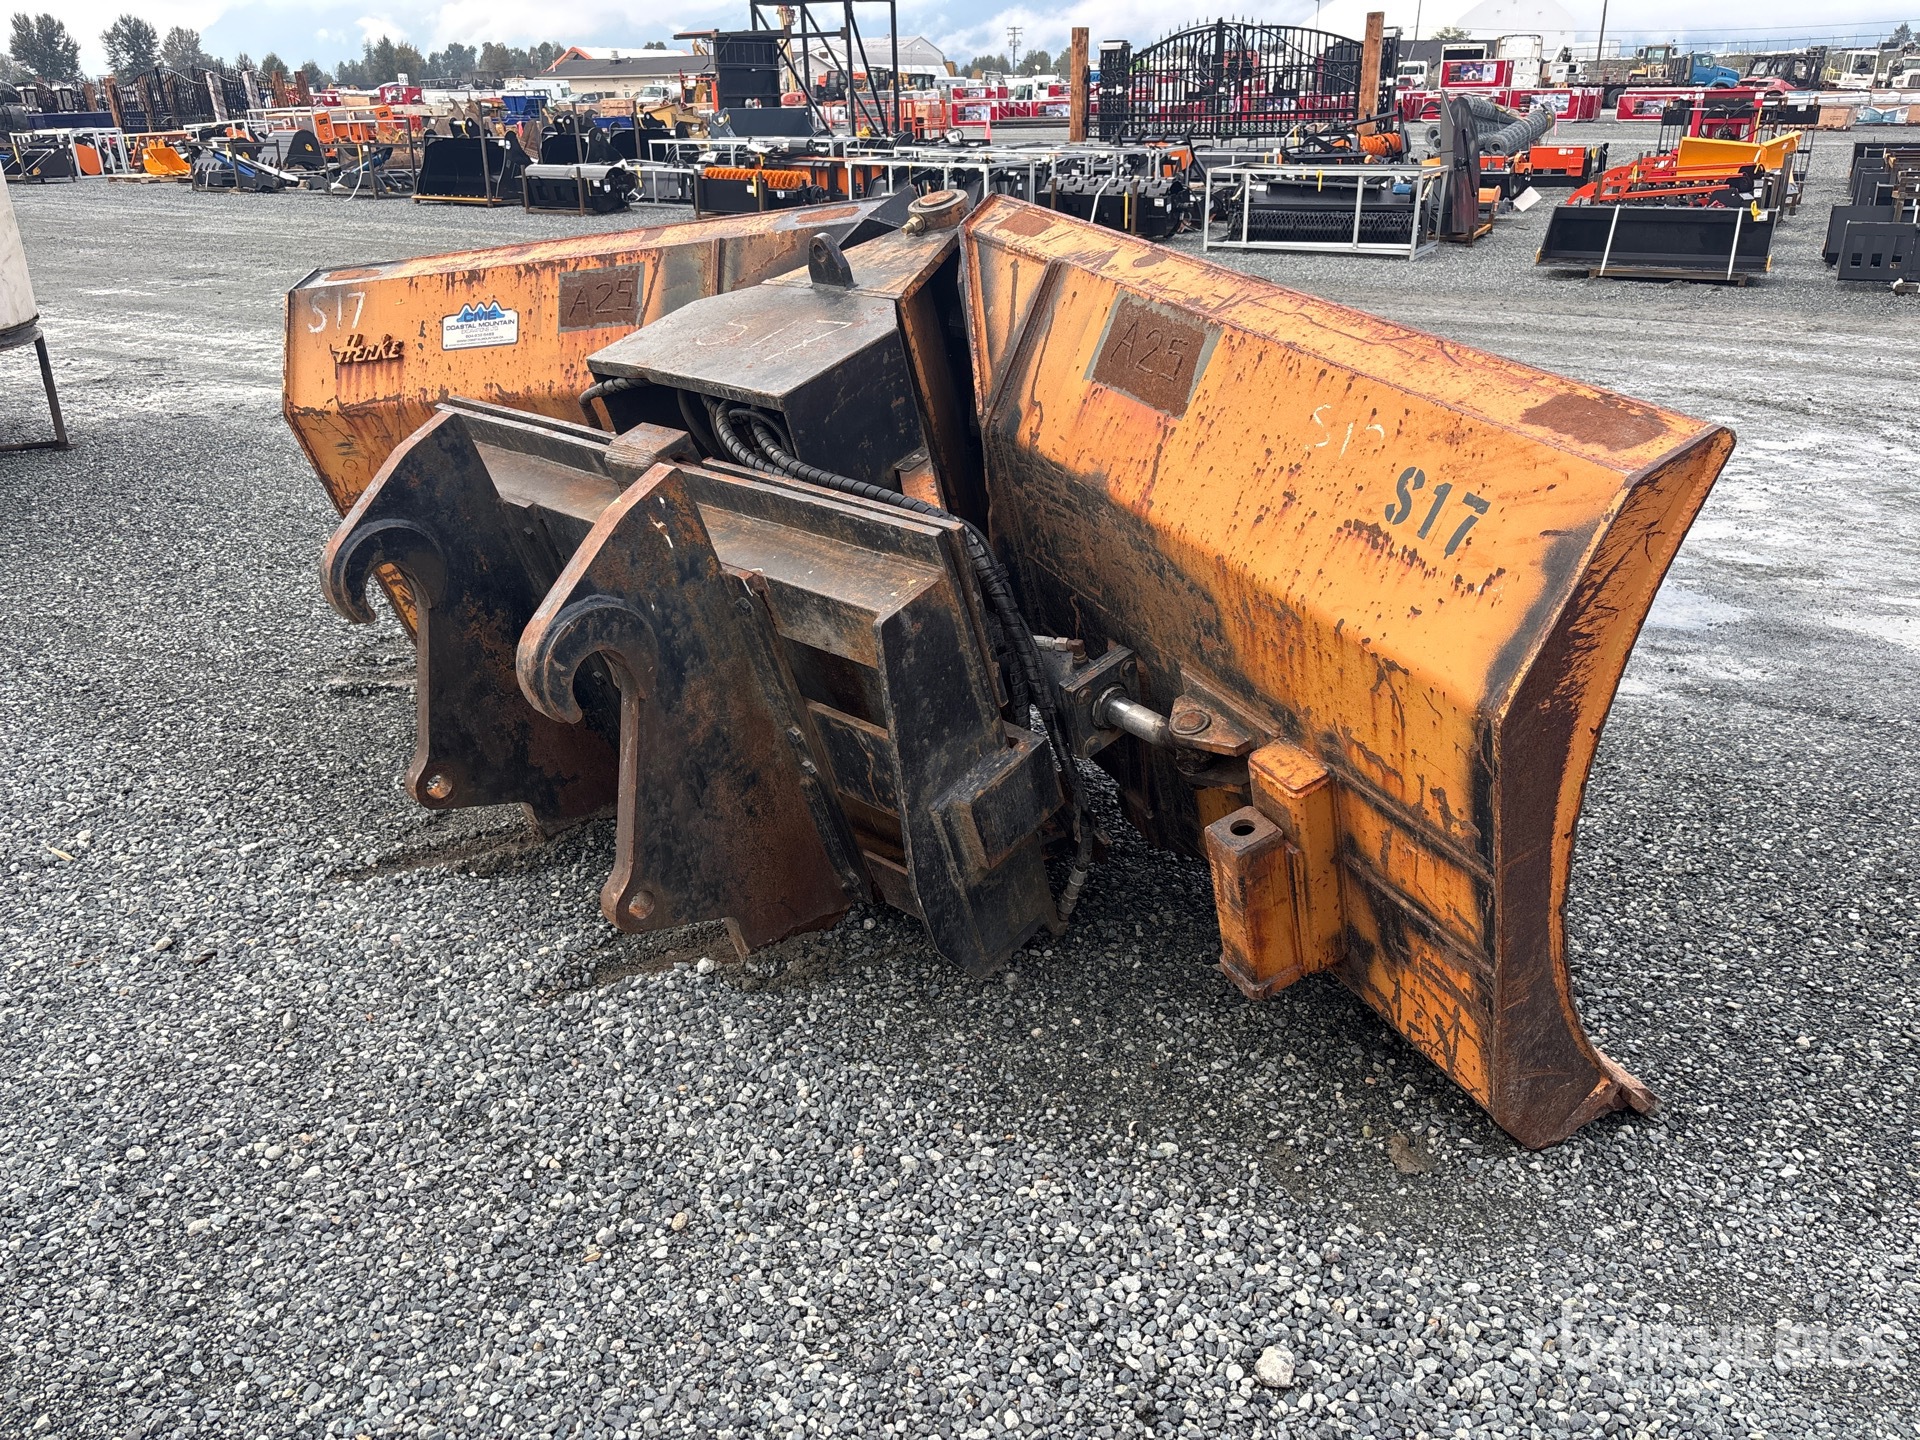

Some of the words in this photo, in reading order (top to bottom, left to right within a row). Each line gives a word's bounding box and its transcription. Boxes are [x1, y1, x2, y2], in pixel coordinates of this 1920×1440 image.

[307, 290, 366, 333] S17
[463, 309, 497, 323] CME
[568, 278, 634, 318] A25
[445, 323, 477, 331] COASTAL
[478, 319, 515, 327] MOUNTAIN
[1108, 319, 1189, 382] A25
[1384, 466, 1492, 560] S17
